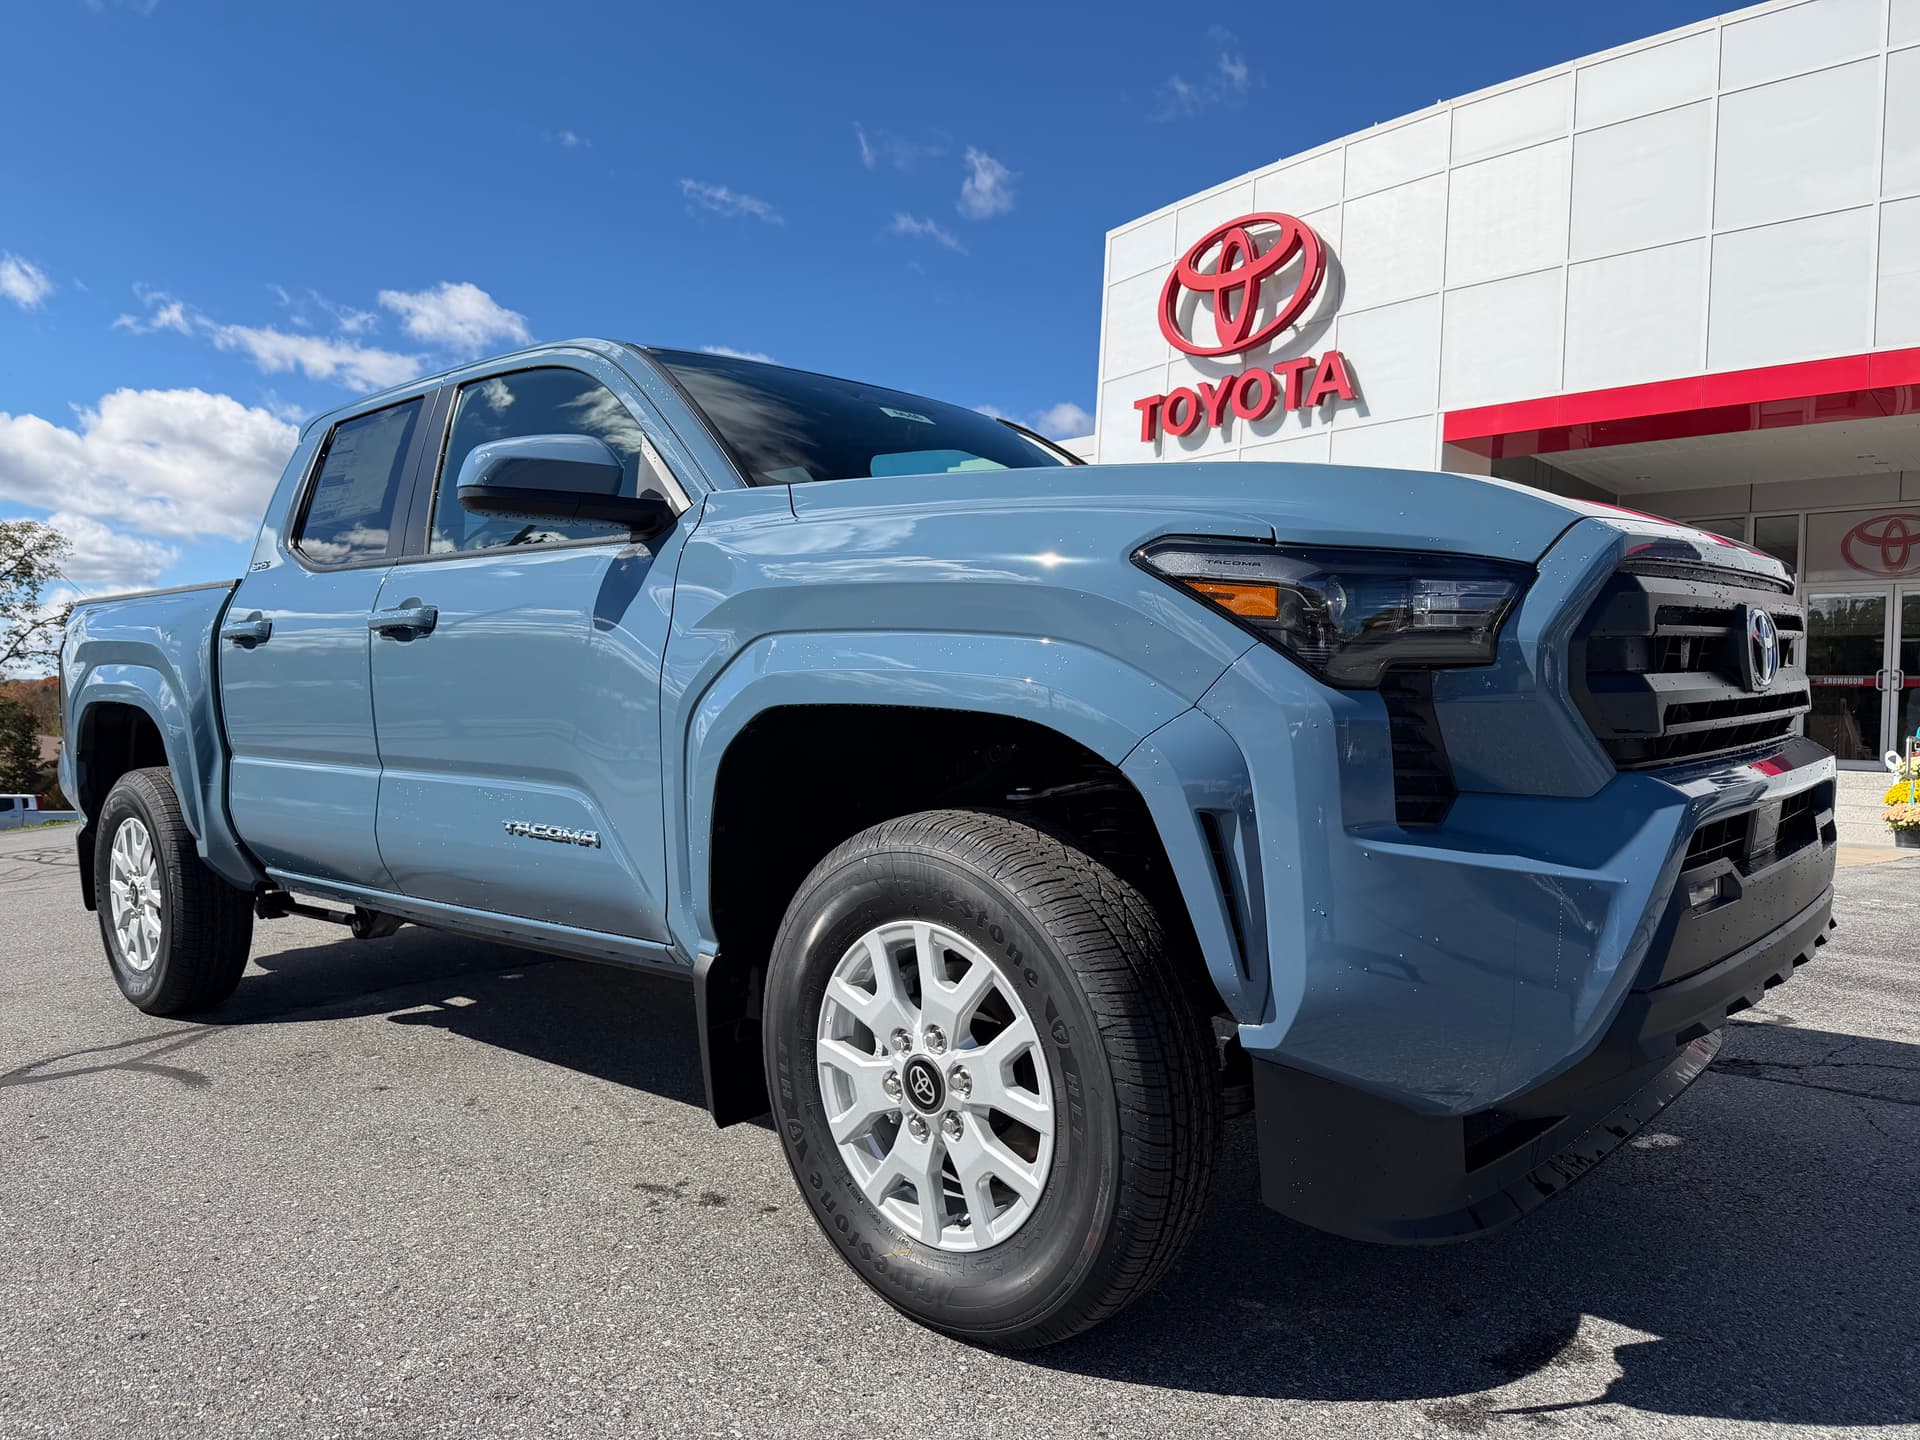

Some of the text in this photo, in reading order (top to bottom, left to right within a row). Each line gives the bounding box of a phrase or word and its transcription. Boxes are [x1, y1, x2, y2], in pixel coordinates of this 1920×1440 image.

[1134, 350, 1359, 442] TOYOTA
[1205, 559, 1261, 567] TACOMA
[1823, 677, 1864, 685] SHOWROOM
[502, 820, 601, 849] TACOMA
